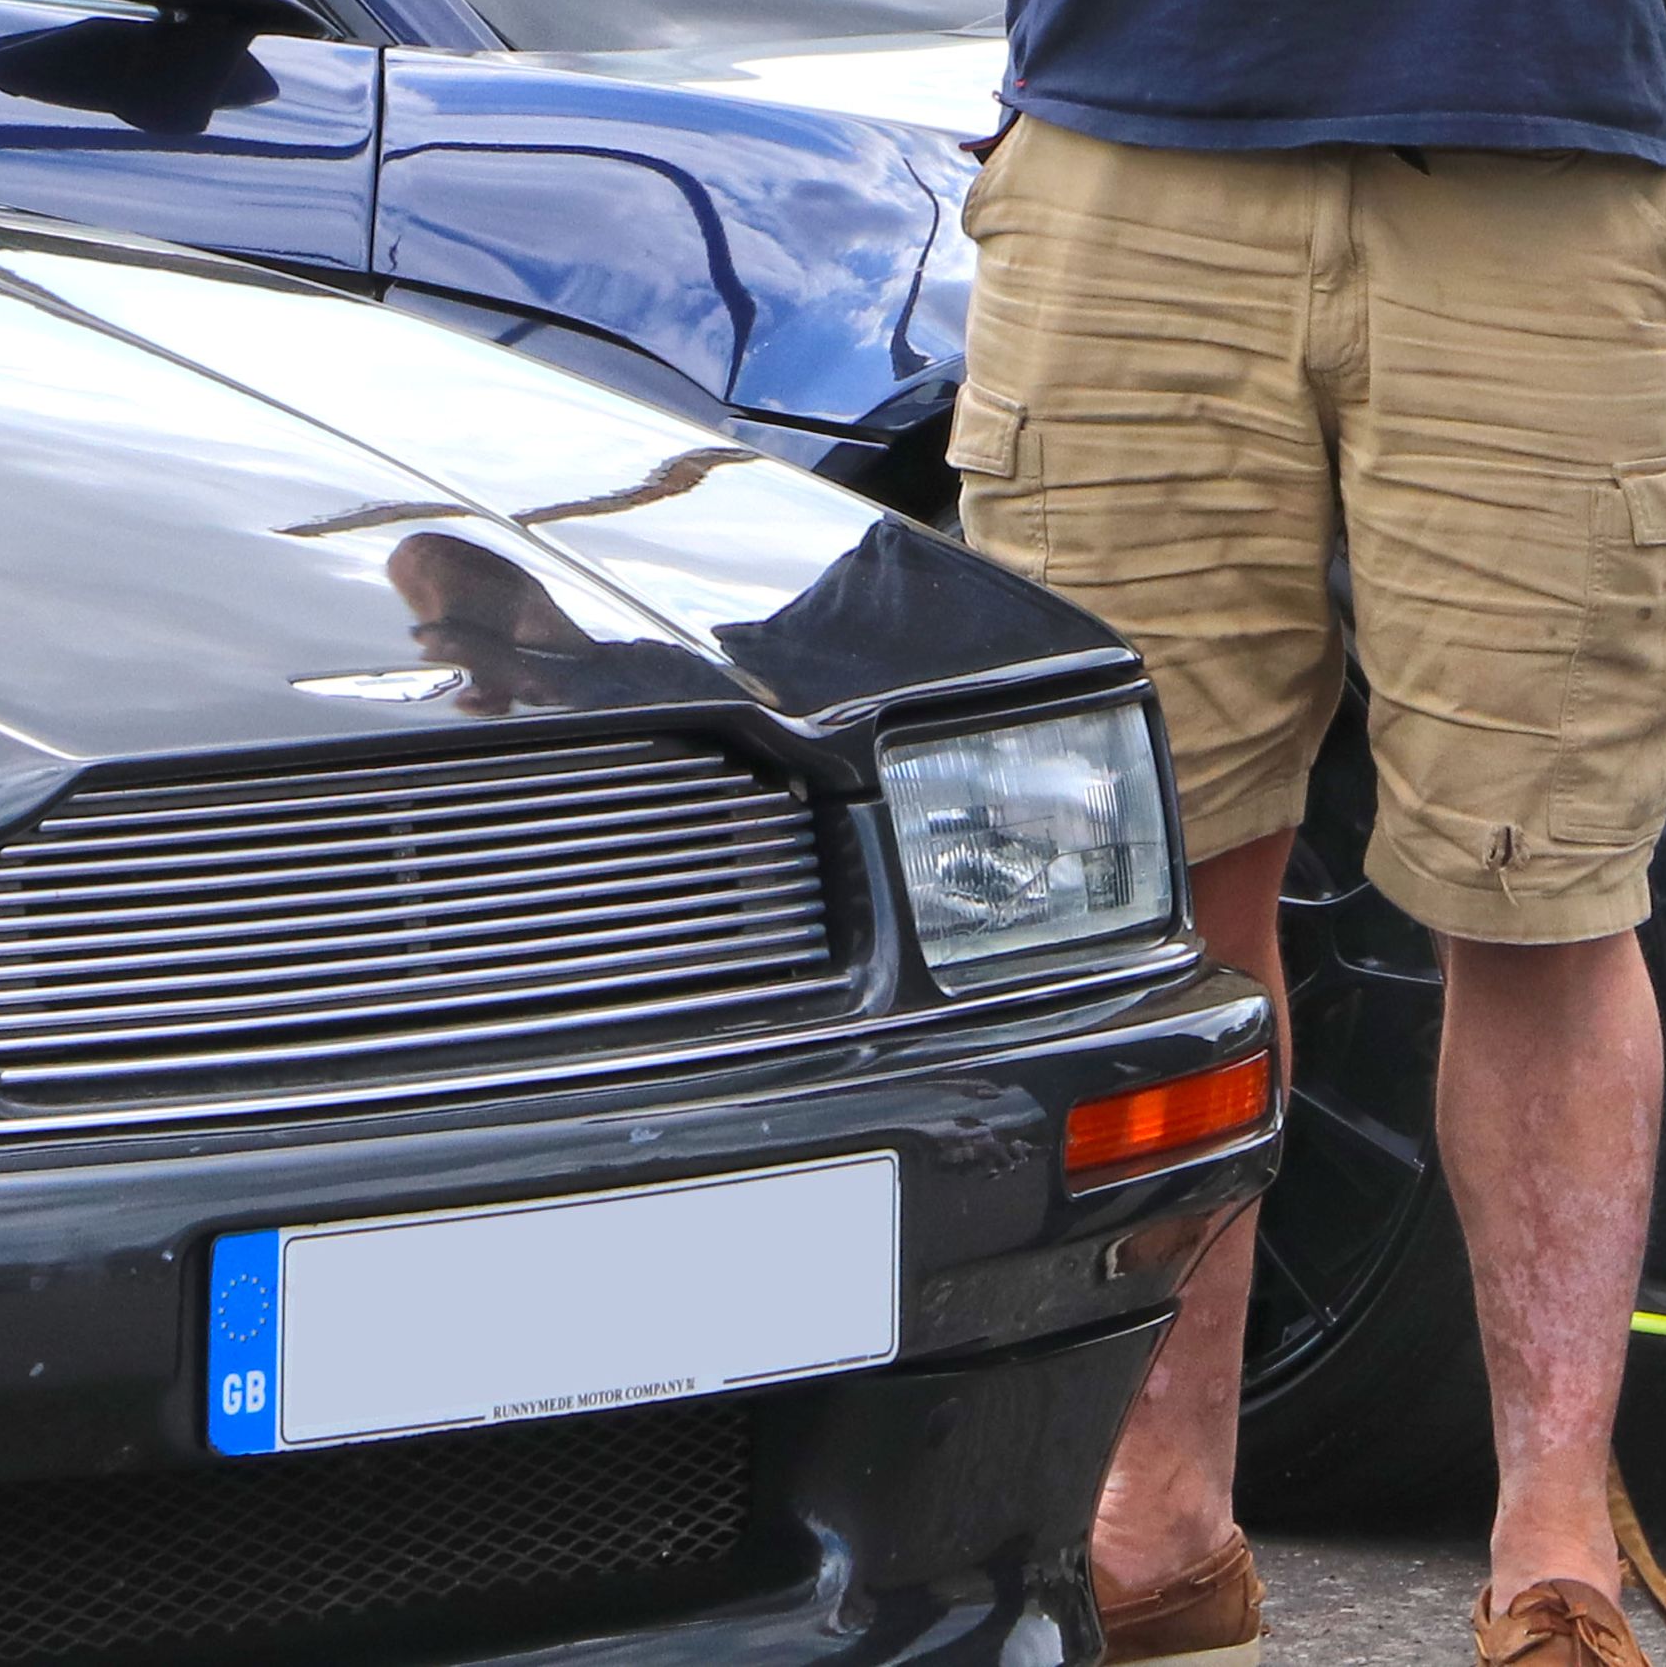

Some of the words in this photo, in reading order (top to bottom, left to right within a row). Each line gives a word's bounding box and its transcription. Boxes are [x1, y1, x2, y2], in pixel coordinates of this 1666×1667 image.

[222, 1369, 266, 1415] GB
[493, 1396, 575, 1419] RUNNYMEDE
[577, 1389, 623, 1407] MOTOR
[625, 1379, 685, 1400] COMPANY
